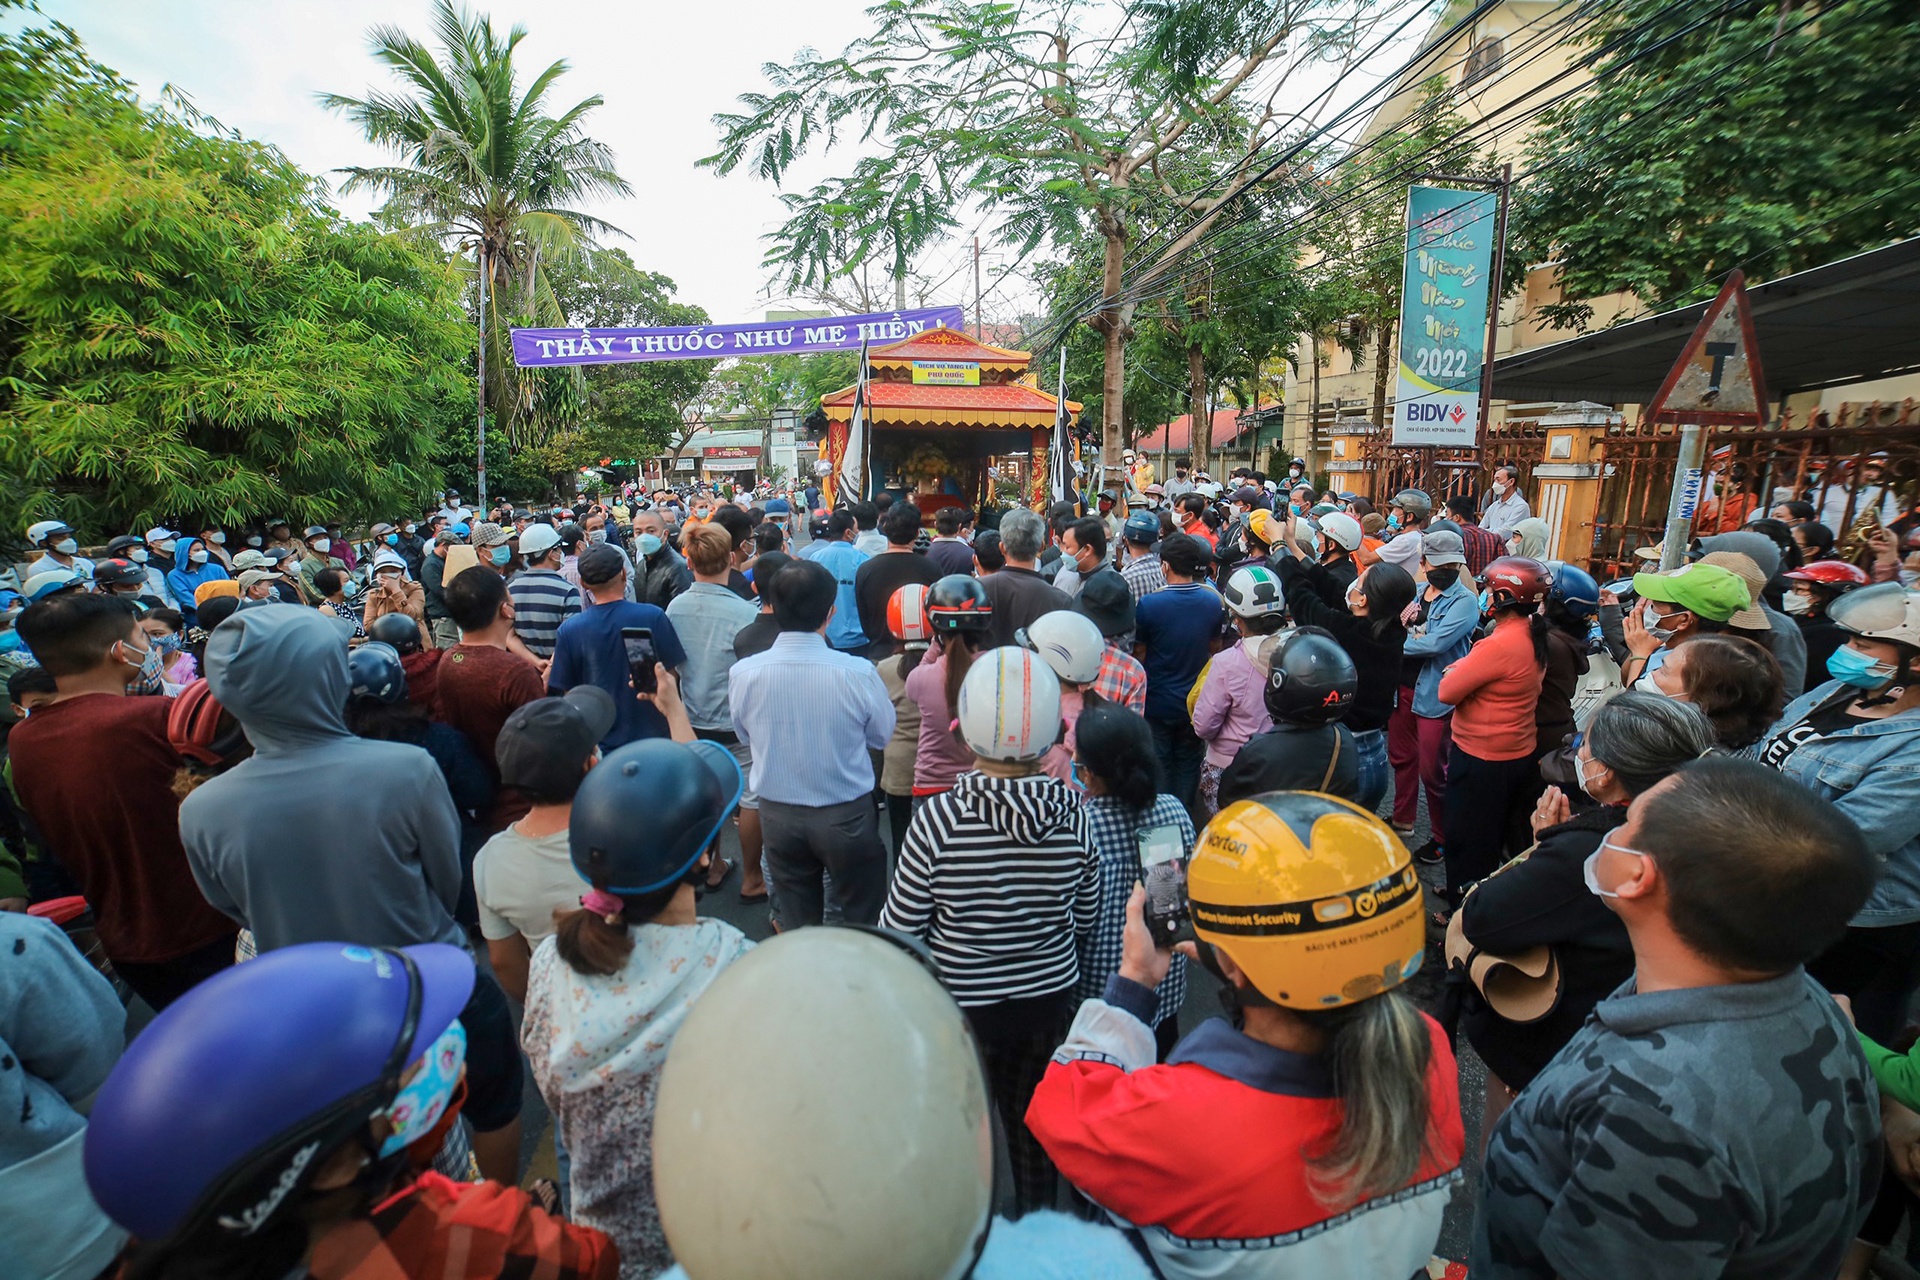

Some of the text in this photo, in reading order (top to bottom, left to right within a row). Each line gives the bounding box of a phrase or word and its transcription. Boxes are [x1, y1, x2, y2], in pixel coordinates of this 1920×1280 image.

[1421, 281, 1465, 311] Năm
[536, 328, 616, 359] THẦY
[624, 327, 725, 353] THUỐC
[734, 325, 796, 348] NHƯ
[804, 324, 846, 348] MẸ
[857, 312, 925, 341] HIỀN
[1422, 314, 1460, 345] Mới
[1416, 347, 1467, 378] 2022
[1407, 403, 1449, 422] BIDV
[1208, 831, 1248, 857] Norton
[1376, 883, 1405, 905] Norton
[1253, 908, 1301, 926] Security
[218, 1141, 321, 1236] Vespa
